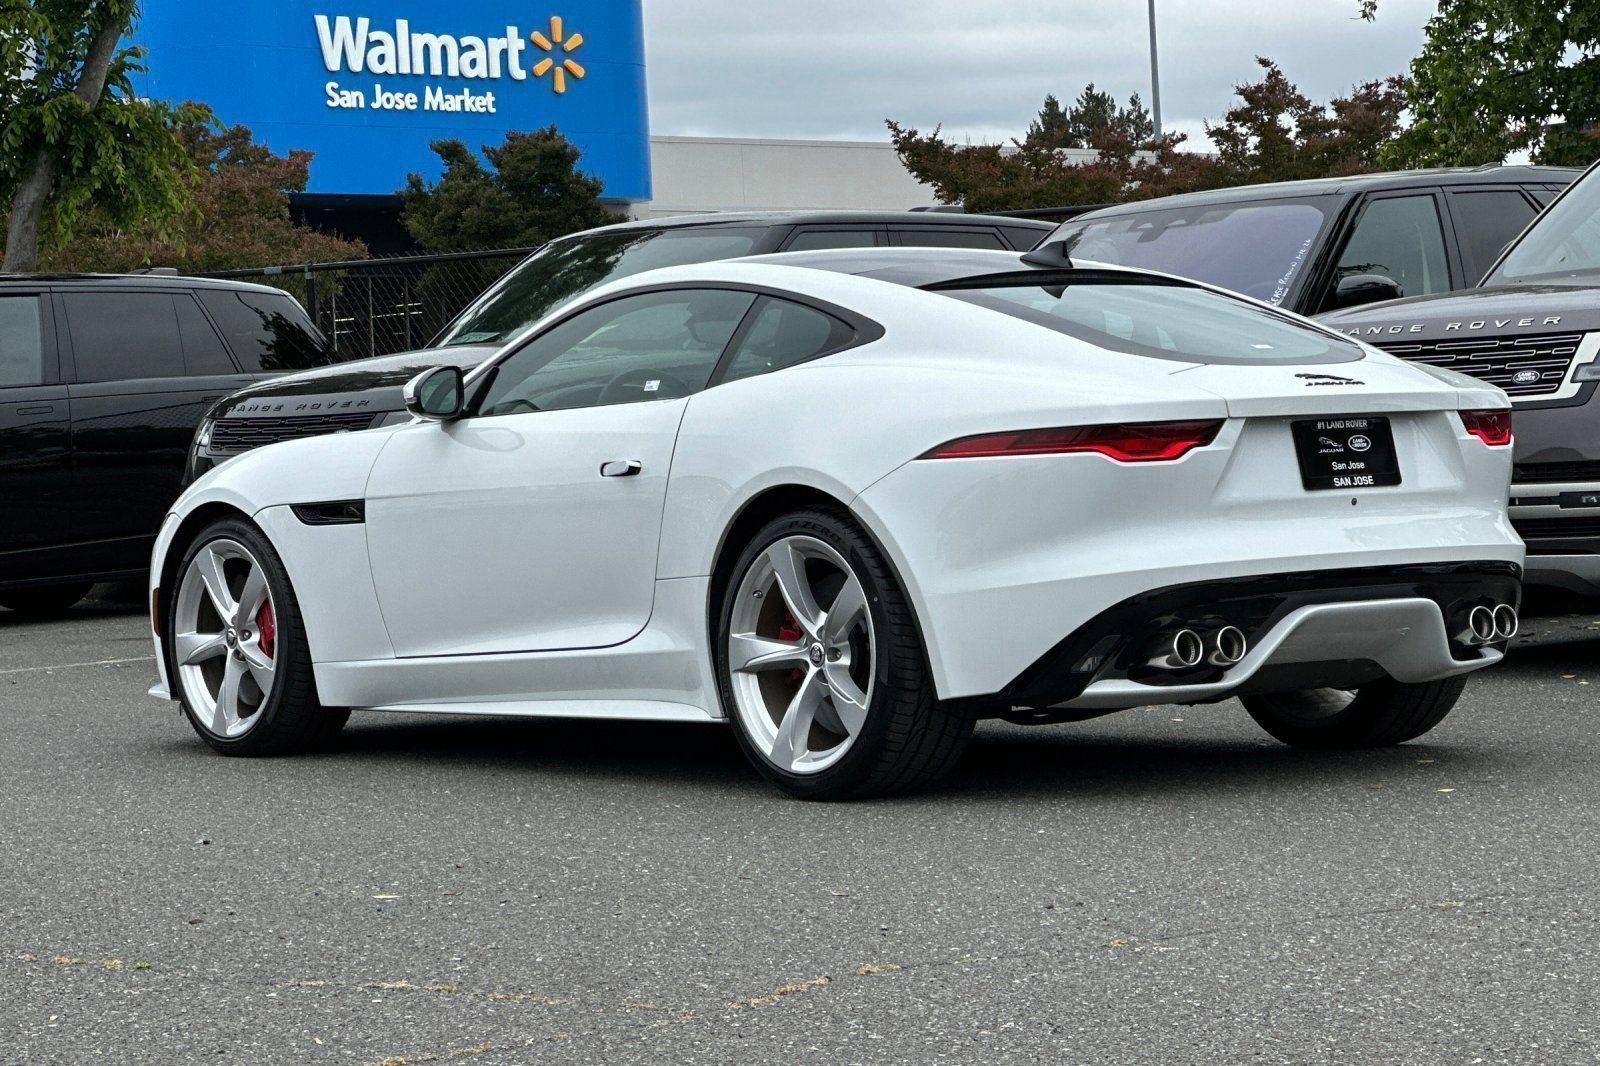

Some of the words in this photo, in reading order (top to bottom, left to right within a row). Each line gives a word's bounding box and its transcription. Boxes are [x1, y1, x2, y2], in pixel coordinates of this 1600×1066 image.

[314, 14, 527, 81] Walmart
[325, 81, 365, 109] San
[371, 83, 418, 111] Jose
[424, 85, 497, 114] Market
[1446, 316, 1562, 332] ROVER
[296, 399, 371, 412] ROVER
[1317, 421, 1325, 430] #1
[1326, 420, 1345, 429] LAND
[1345, 419, 1368, 429] ROVER
[1331, 461, 1347, 470] San
[1347, 460, 1365, 470] Jose
[1333, 476, 1352, 487] SAN
[1352, 475, 1375, 486] JOSE
